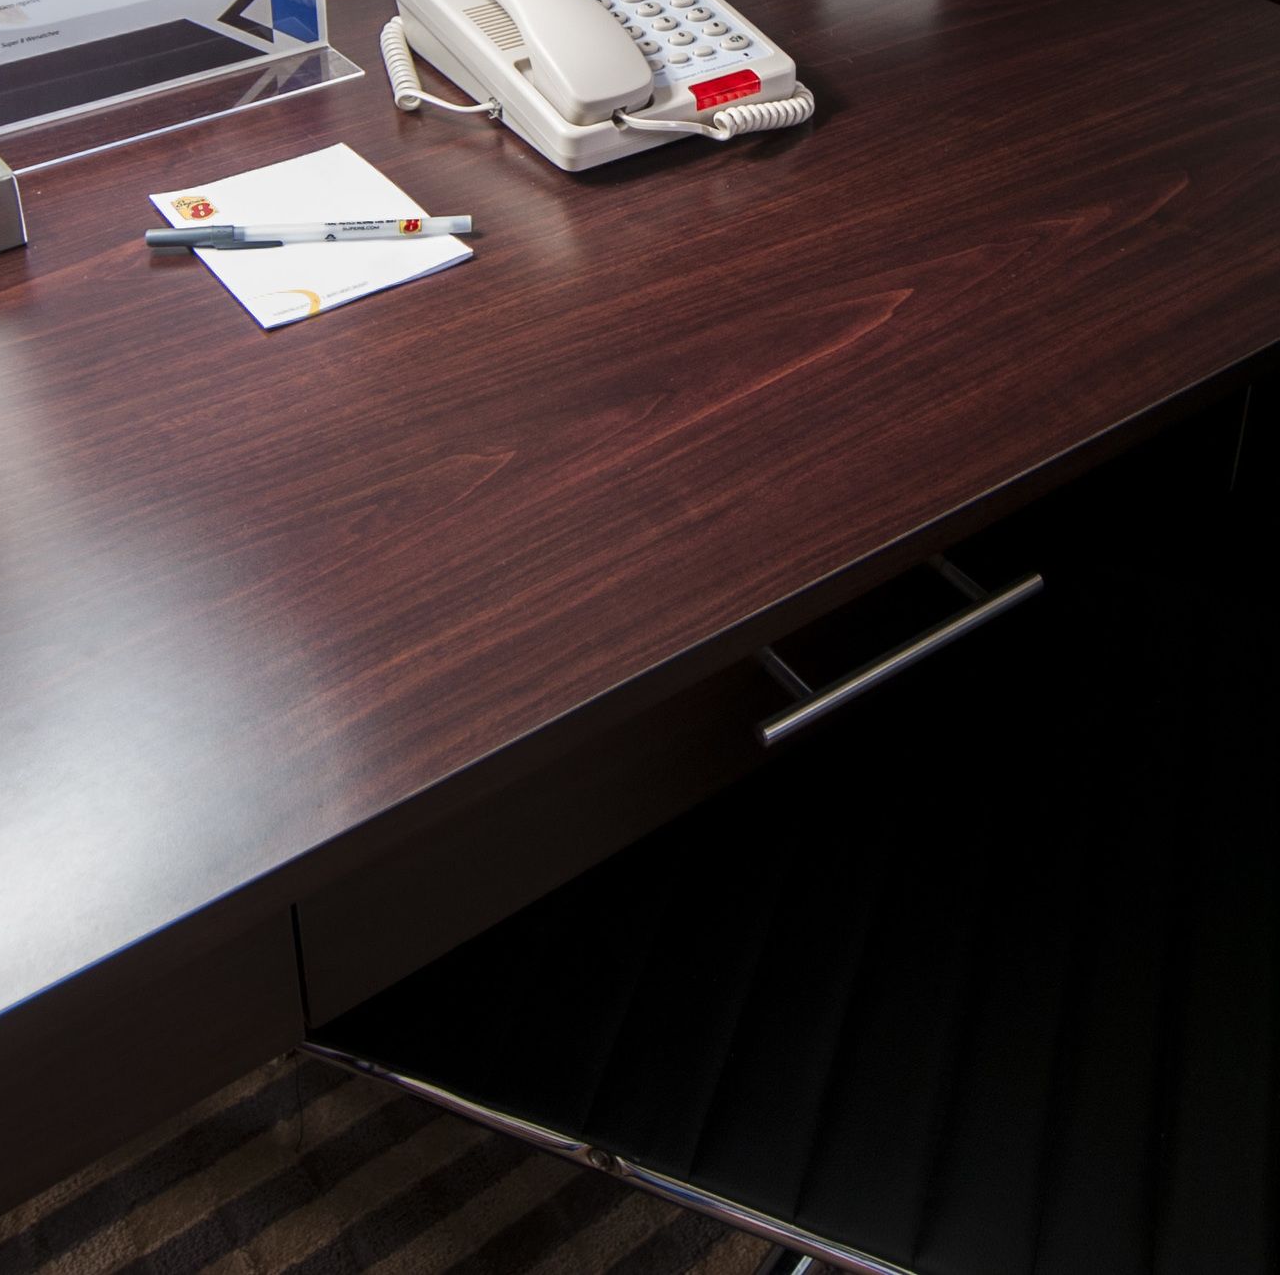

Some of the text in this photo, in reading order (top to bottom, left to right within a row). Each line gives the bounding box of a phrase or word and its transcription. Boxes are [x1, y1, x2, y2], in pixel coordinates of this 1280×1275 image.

[1, 40, 19, 48] Super
[26, 30, 60, 42] Wenatchee
[191, 203, 214, 219] 8
